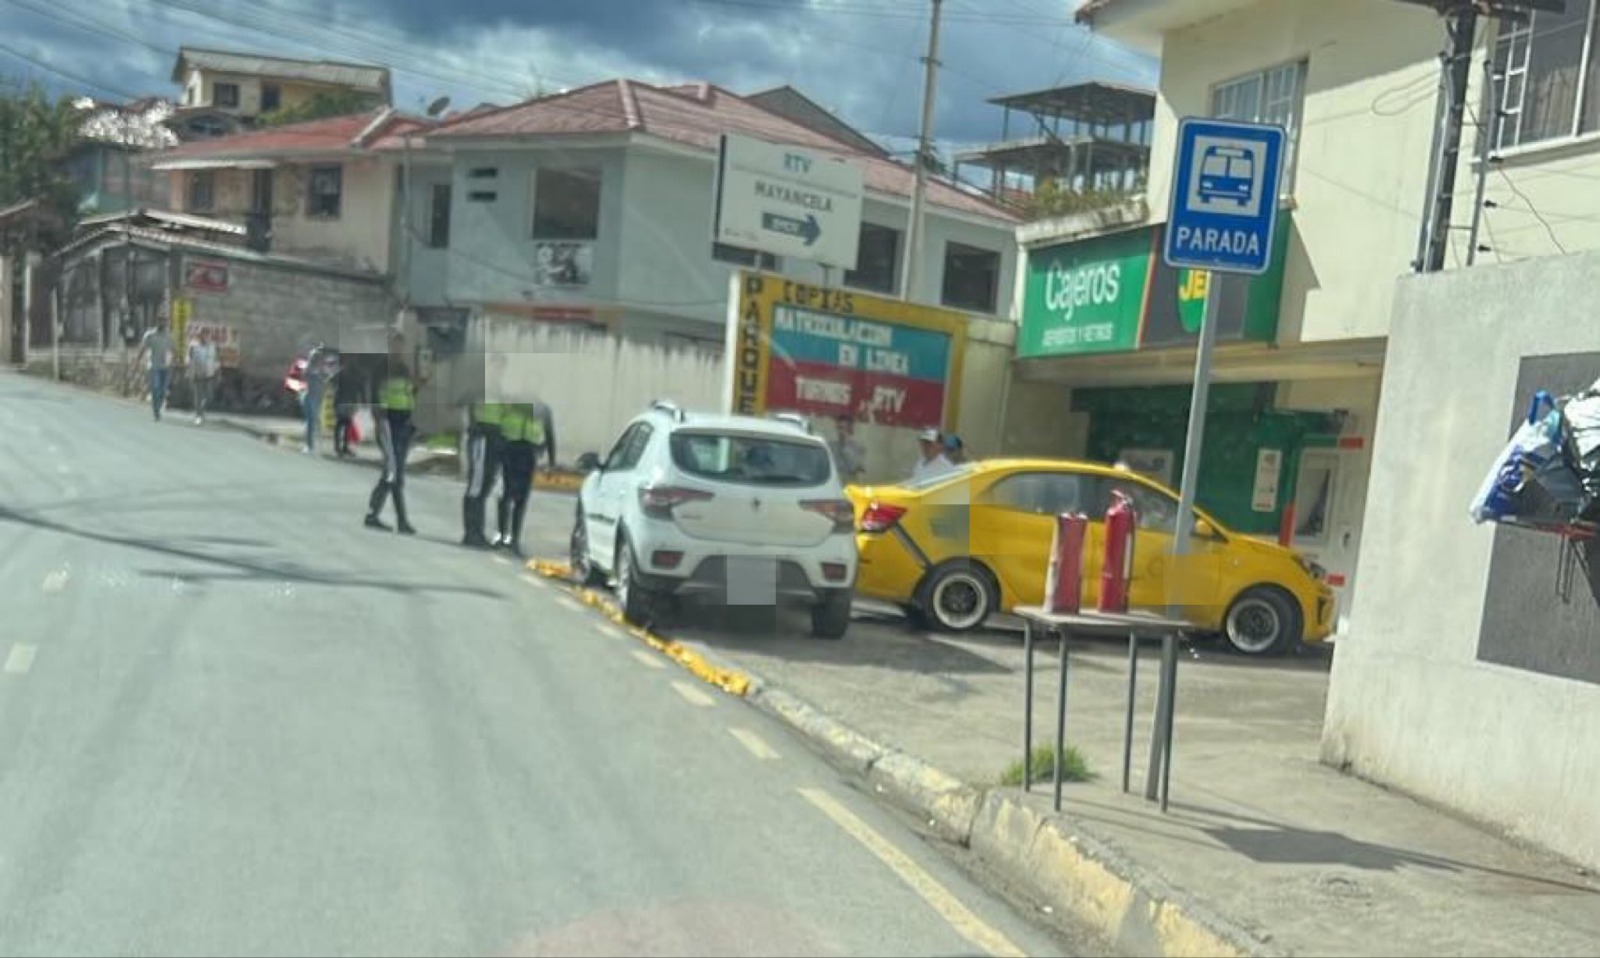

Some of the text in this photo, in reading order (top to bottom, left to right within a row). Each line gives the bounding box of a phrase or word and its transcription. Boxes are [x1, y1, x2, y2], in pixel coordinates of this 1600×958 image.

[783, 153, 812, 173] RTV
[754, 181, 833, 212] MAYANCELA
[1176, 226, 1259, 256] PARADA
[783, 280, 854, 313] COPIAS
[1046, 260, 1120, 321] Cajeros
